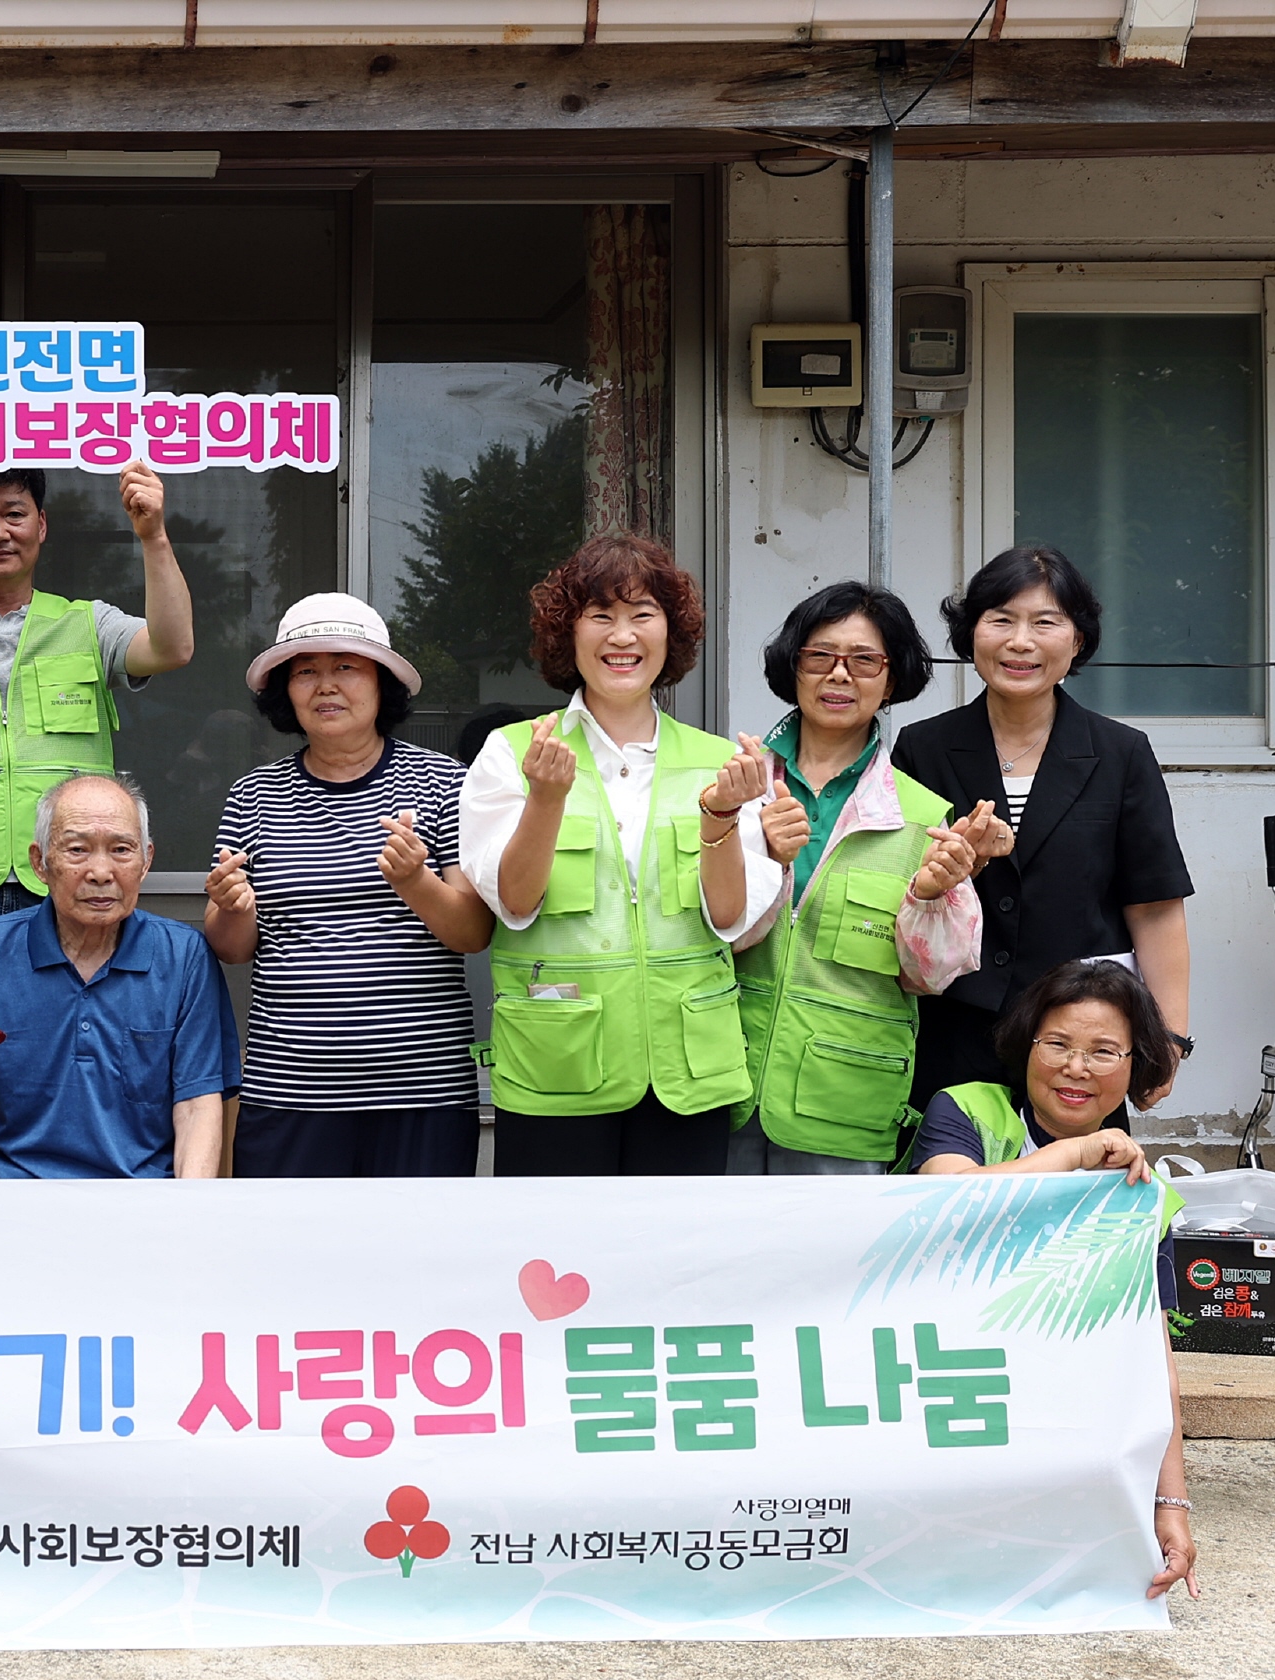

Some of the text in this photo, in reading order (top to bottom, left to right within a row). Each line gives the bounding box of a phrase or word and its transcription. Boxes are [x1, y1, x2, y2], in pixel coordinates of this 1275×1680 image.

[294, 630, 308, 638] LIVE
[872, 924, 889, 932] 신전면
[1221, 1268, 1271, 1284] 베지밀
[177, 1328, 526, 1459] 사랑의
[564, 1324, 759, 1453] 물품
[795, 1322, 1011, 1448] 나눔
[732, 1498, 851, 1522] 사랑의열매
[469, 1526, 849, 1571] 전남 사회복지공동모금회
